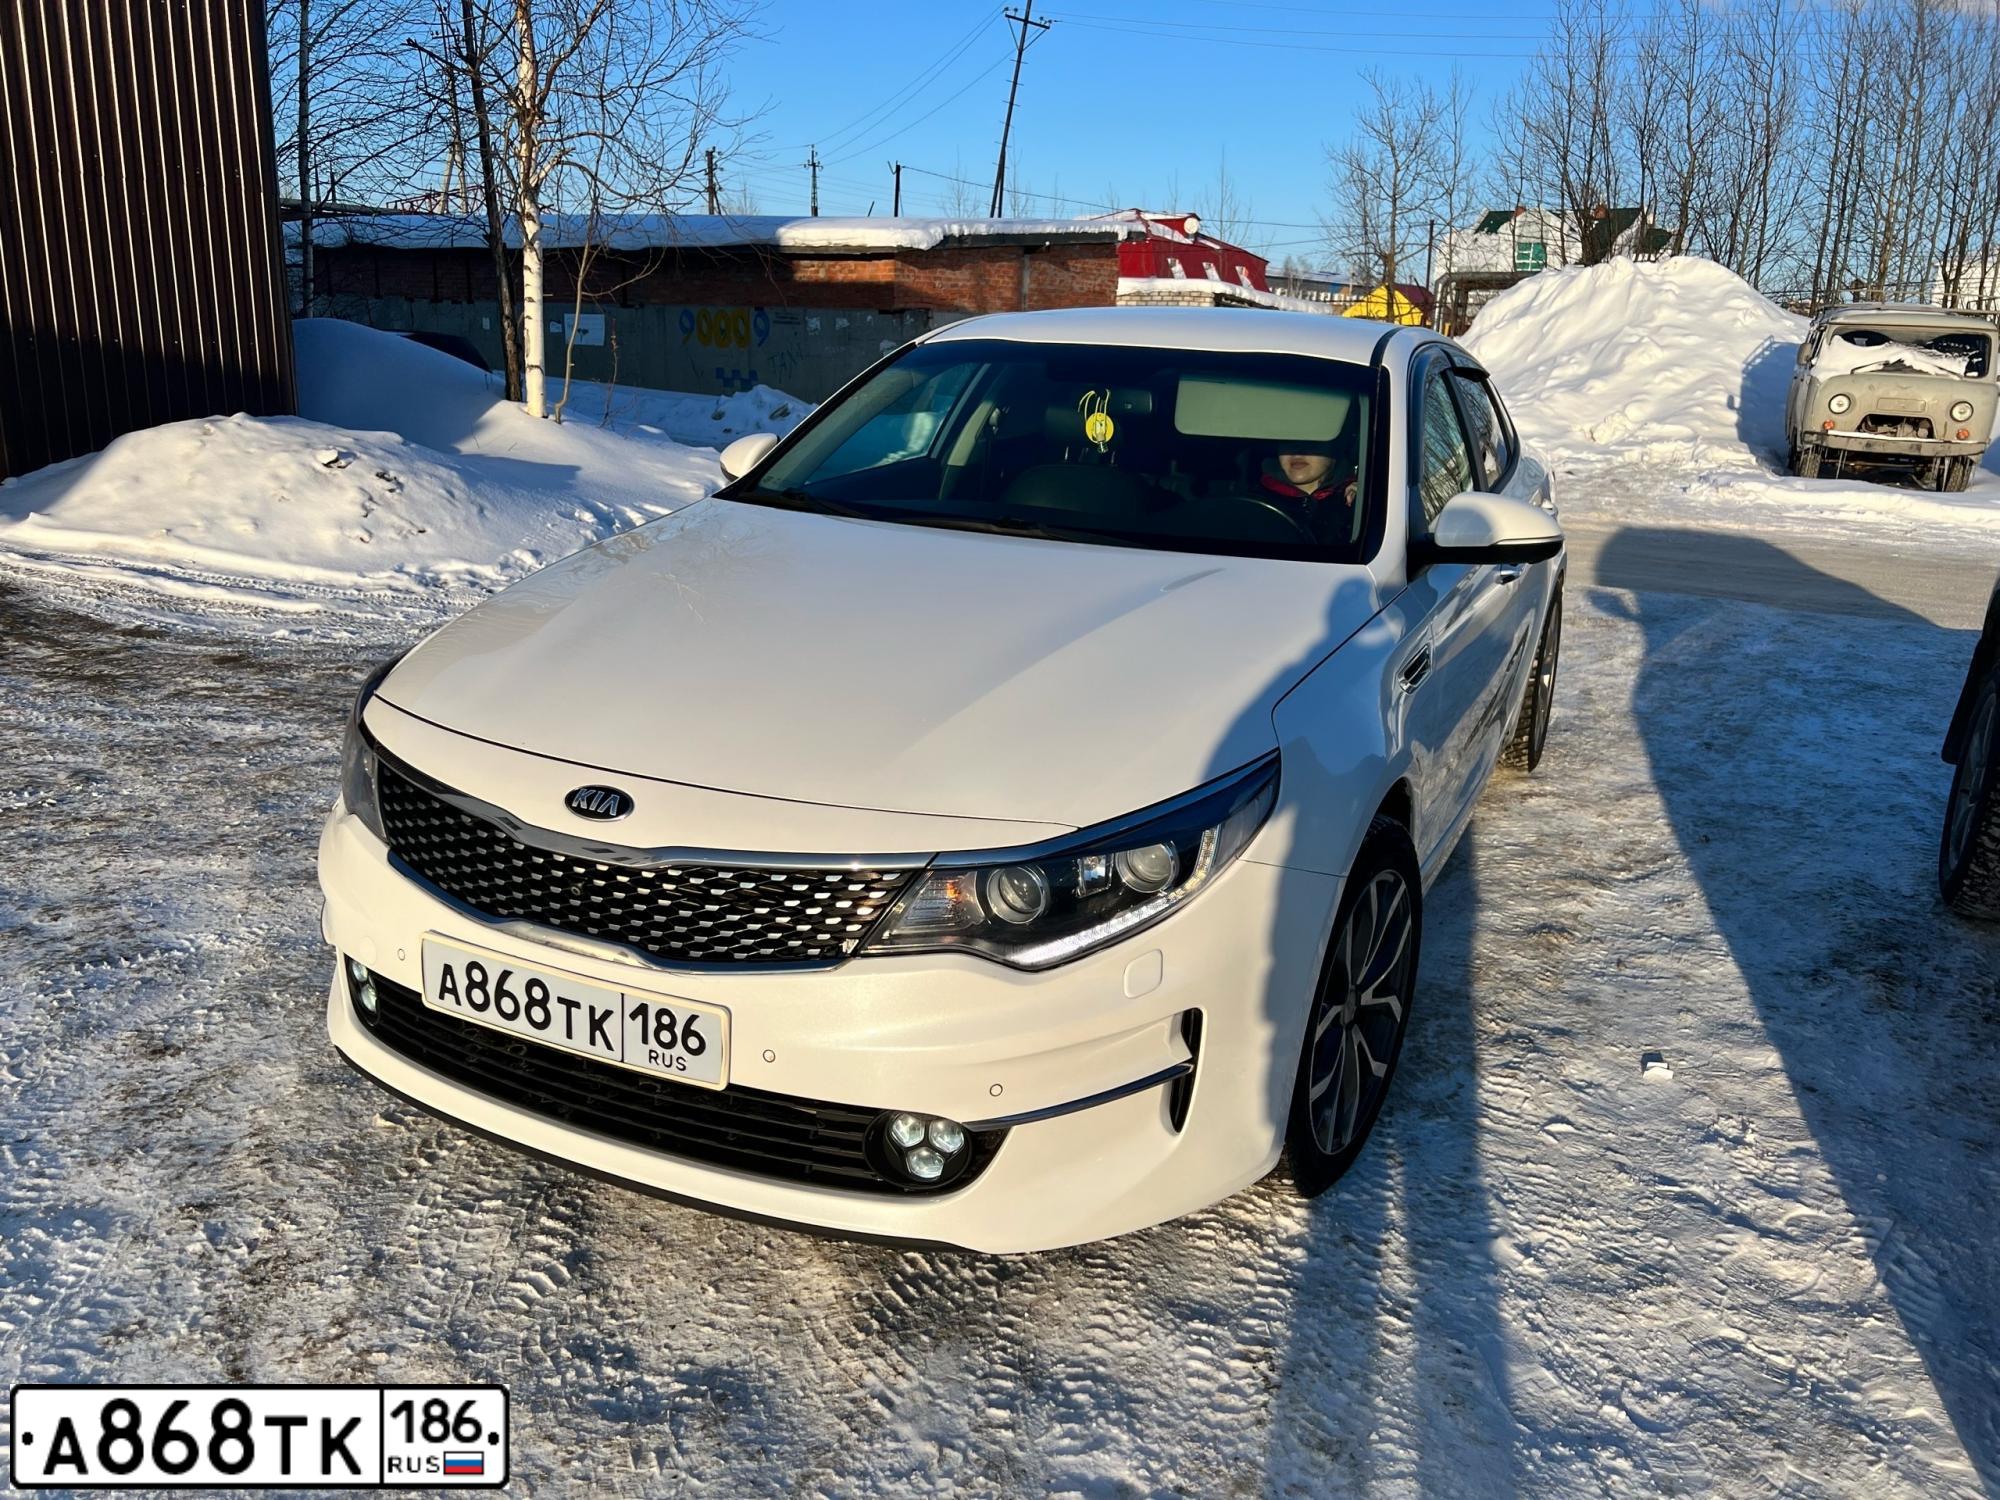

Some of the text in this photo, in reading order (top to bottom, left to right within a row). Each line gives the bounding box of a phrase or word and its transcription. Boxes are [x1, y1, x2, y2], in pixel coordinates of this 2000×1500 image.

[571, 788, 620, 817] KIA
[628, 1002, 707, 1057] 186
[649, 1048, 687, 1072] RUS
